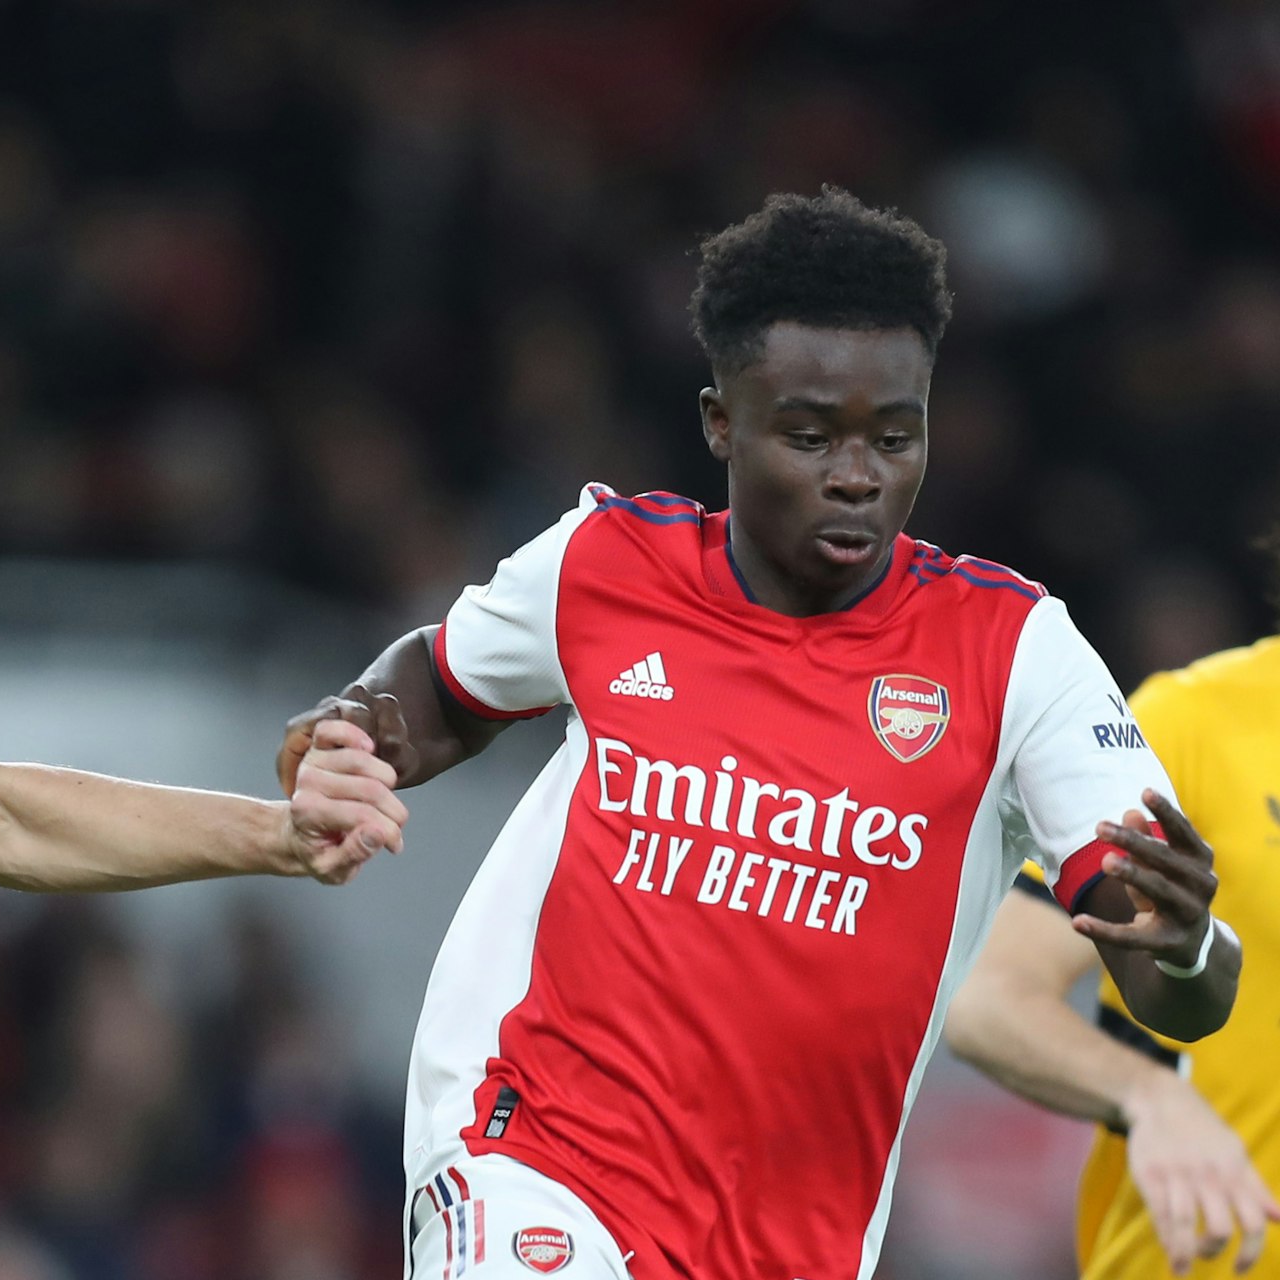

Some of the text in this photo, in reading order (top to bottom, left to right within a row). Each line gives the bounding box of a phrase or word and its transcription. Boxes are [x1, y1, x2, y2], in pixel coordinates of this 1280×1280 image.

[609, 678, 674, 701] adidas
[881, 685, 939, 706] Arsenal
[595, 736, 928, 871] Emirates
[612, 828, 869, 936] FLY BETTER
[520, 1232, 566, 1246] Arsenal
